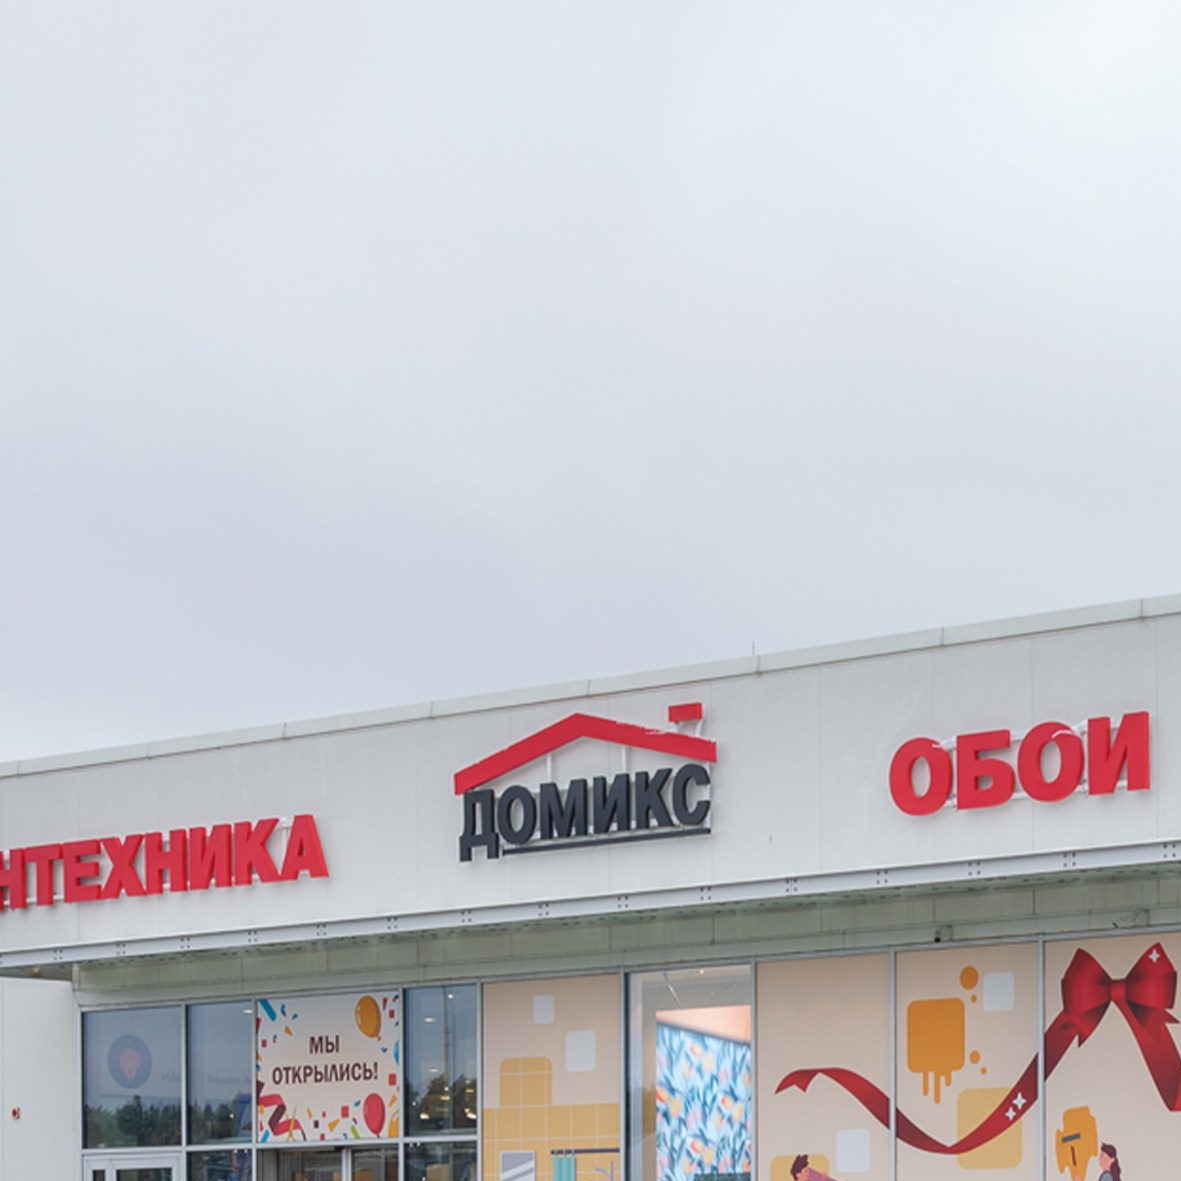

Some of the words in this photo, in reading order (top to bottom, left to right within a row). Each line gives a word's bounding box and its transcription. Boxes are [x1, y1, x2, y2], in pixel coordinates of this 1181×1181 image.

[889, 711, 1151, 816] ОБОИ
[459, 764, 712, 862] ДОМИКС
[271, 1061, 379, 1086] ОТКРЫЛИСЬ!
[308, 1034, 340, 1055] МЫ
